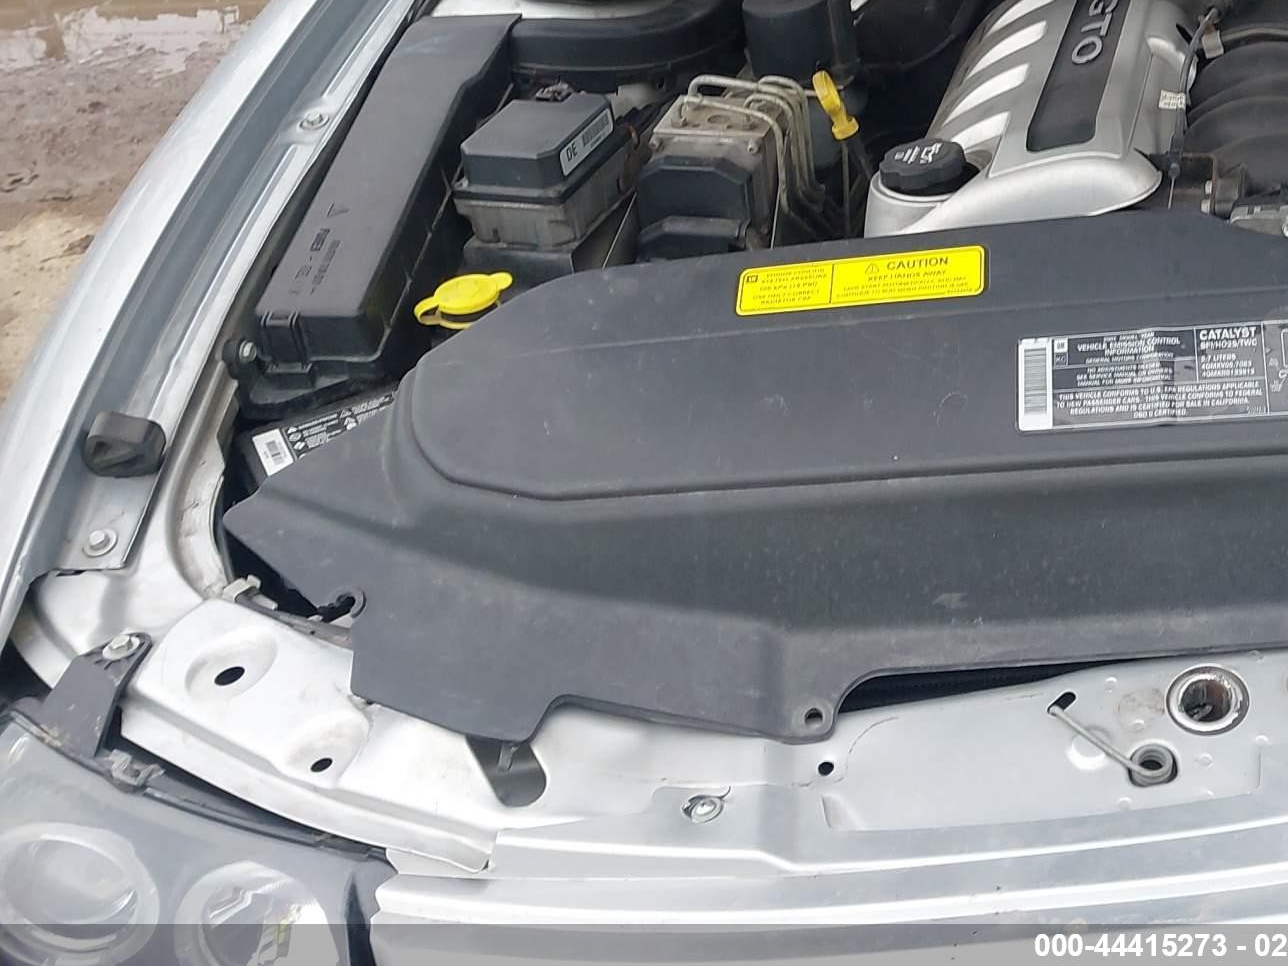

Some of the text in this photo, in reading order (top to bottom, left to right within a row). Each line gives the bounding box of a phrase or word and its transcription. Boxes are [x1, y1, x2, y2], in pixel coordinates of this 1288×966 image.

[565, 141, 578, 163] DE
[887, 256, 949, 271] CAUTION
[1200, 327, 1256, 341] CATALYST
[1077, 342, 1107, 352] VEHICLE
[1147, 337, 1181, 346] CONTROL
